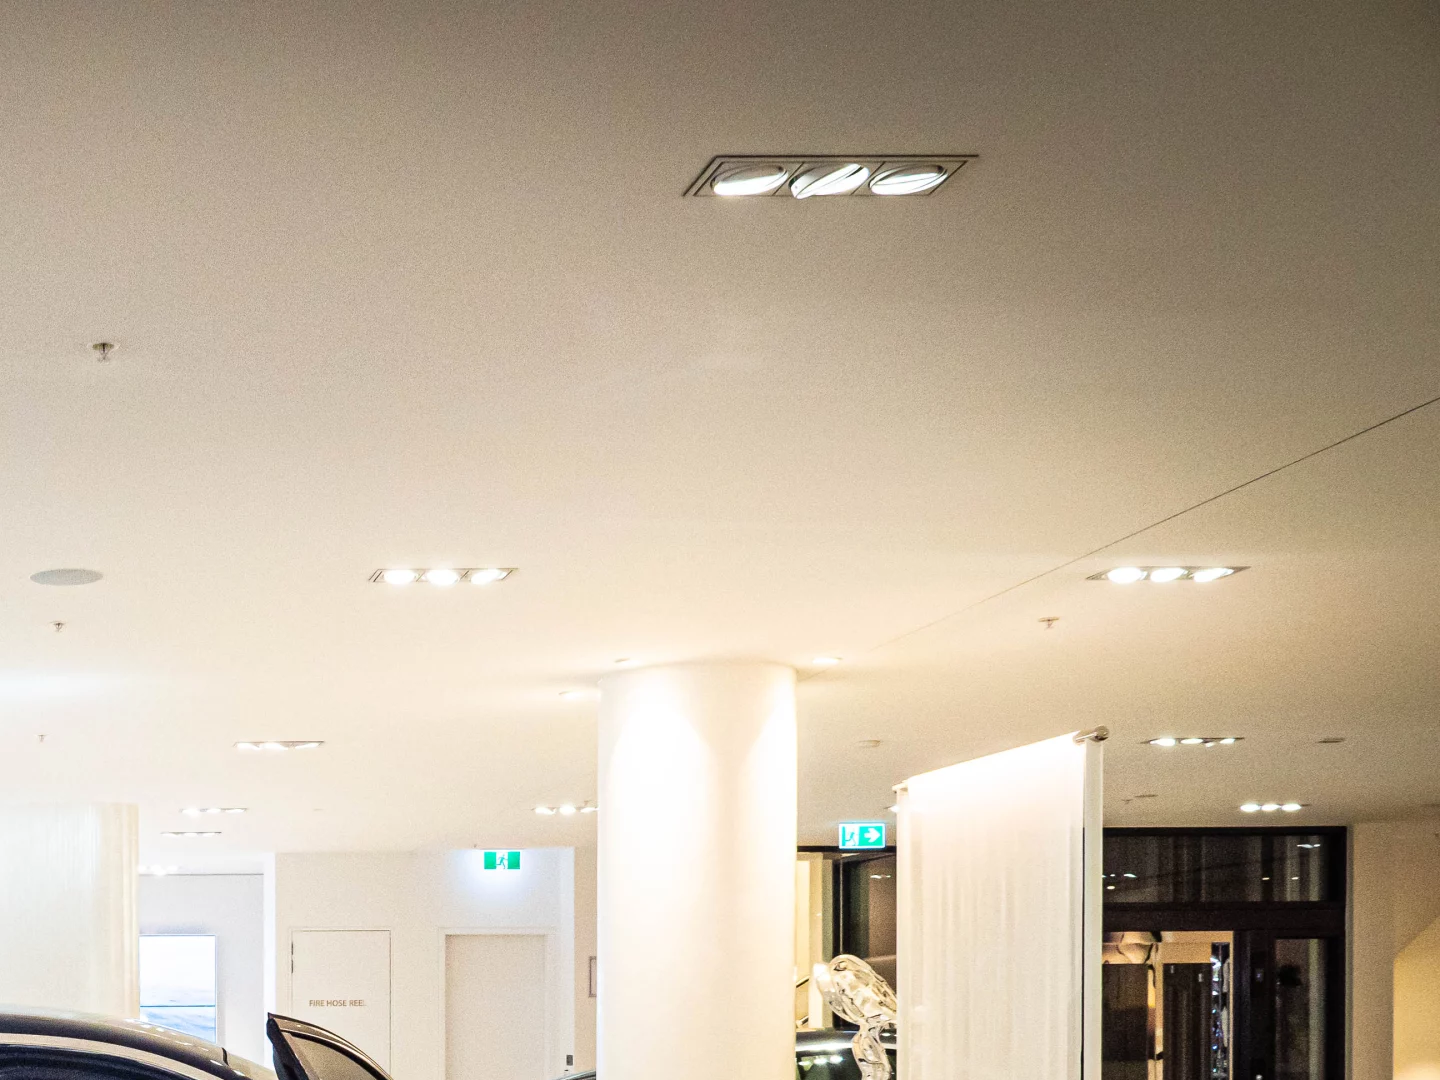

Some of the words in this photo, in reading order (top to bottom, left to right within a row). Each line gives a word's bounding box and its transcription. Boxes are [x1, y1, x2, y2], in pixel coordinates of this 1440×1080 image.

[309, 999, 325, 1007] FIRE
[326, 999, 347, 1007] HOSE
[349, 999, 367, 1007] REEL
